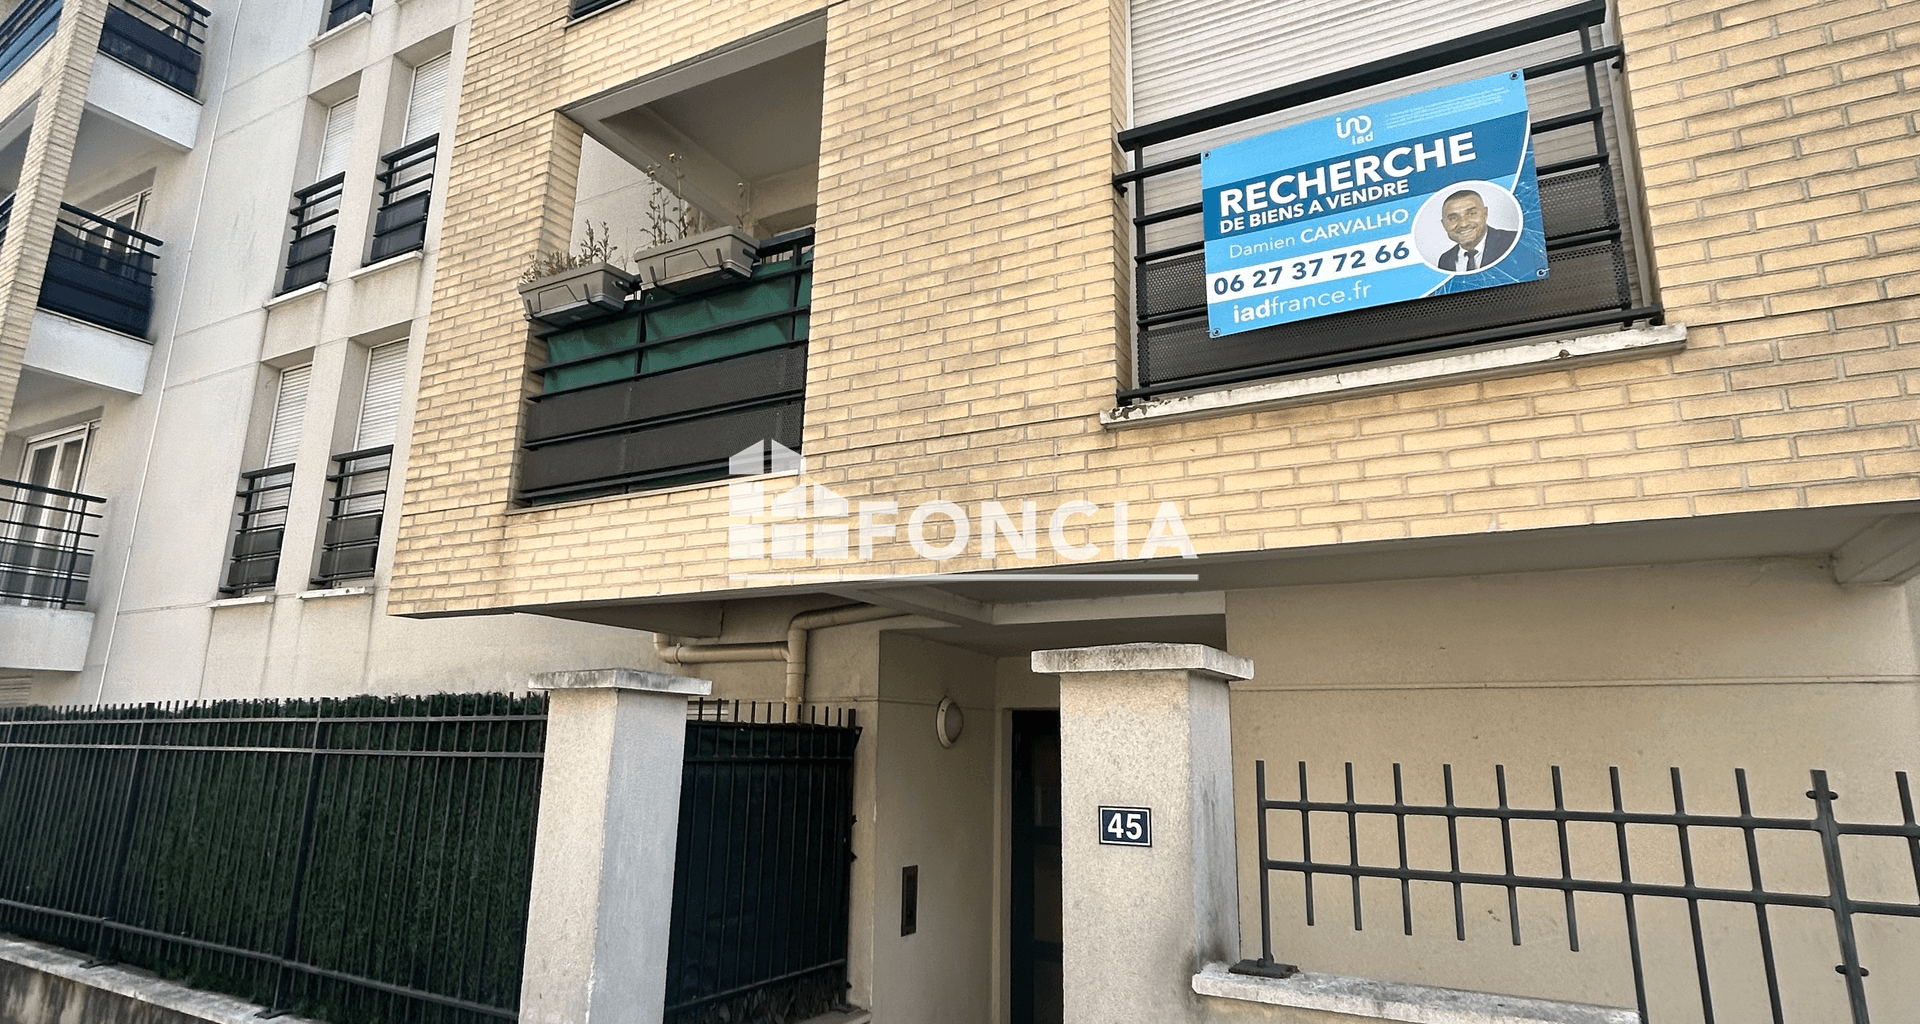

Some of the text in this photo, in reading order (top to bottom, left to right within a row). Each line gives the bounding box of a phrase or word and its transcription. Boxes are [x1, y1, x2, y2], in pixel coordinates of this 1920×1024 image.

[1352, 131, 1374, 145] iad
[1220, 131, 1477, 218] RECHERCHE
[1220, 179, 1410, 234] DE BIENS A VENDRE
[1229, 208, 1410, 259] Damien CARVALHO
[1214, 241, 1410, 296] 06 27 37 72 66
[1233, 280, 1372, 324] iadfrance.fr
[1108, 812, 1143, 840] 45
